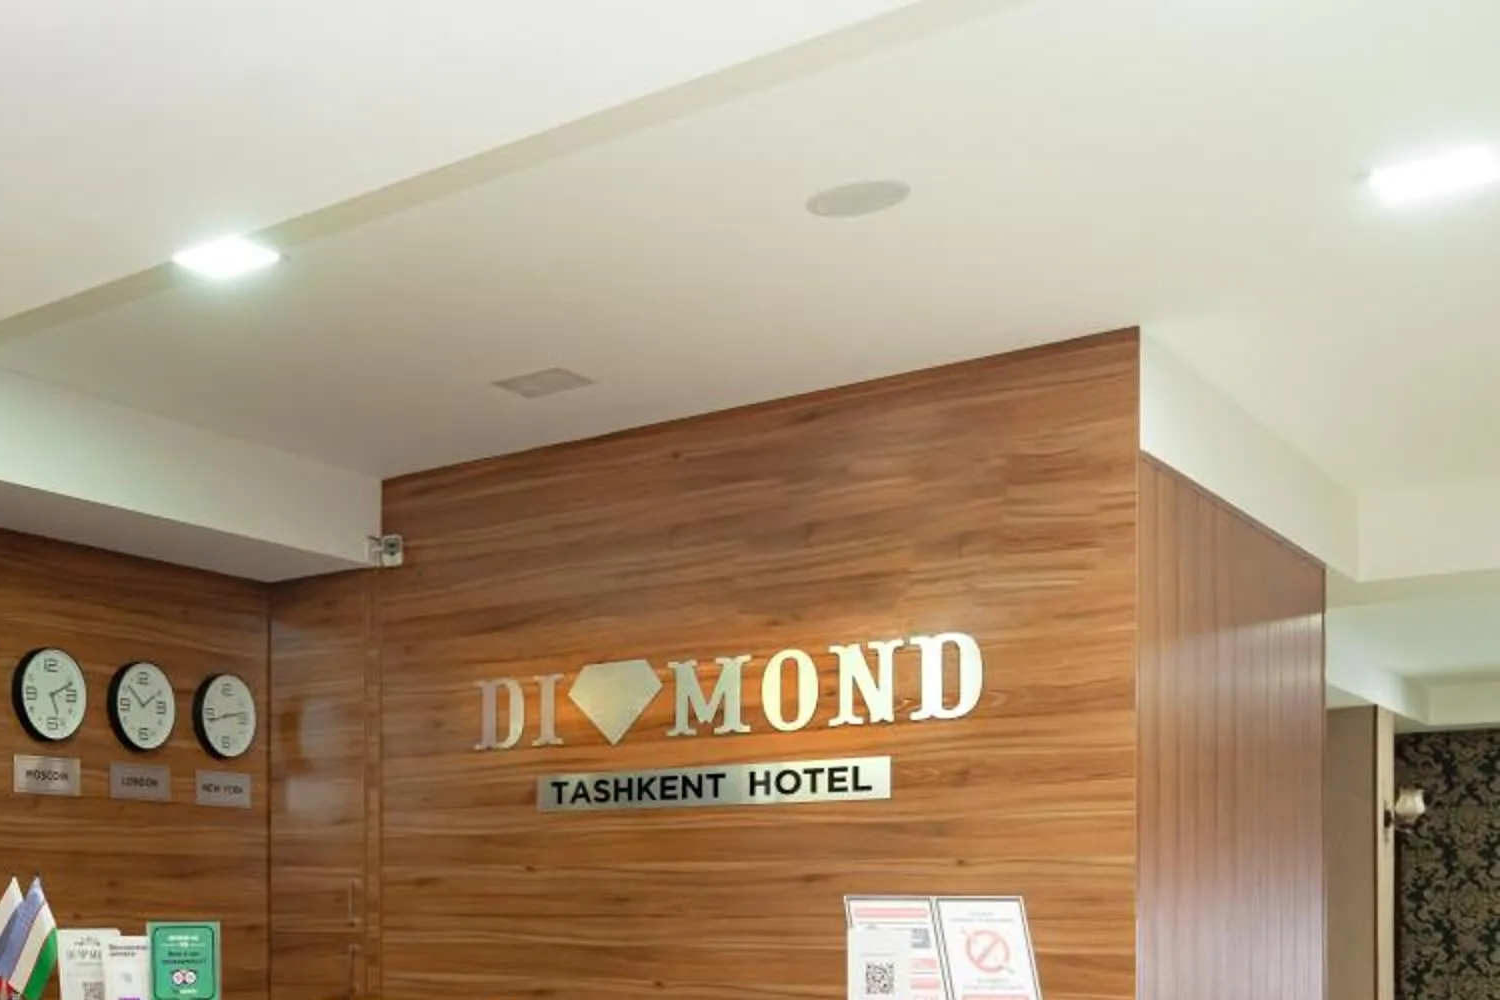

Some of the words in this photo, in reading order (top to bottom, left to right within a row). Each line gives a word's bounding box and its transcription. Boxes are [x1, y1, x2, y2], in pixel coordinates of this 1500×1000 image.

[25, 769, 69, 781] MOSCOW
[121, 776, 159, 787] LONDON
[551, 772, 726, 805] TASHKENT
[749, 765, 872, 797] HOTEL
